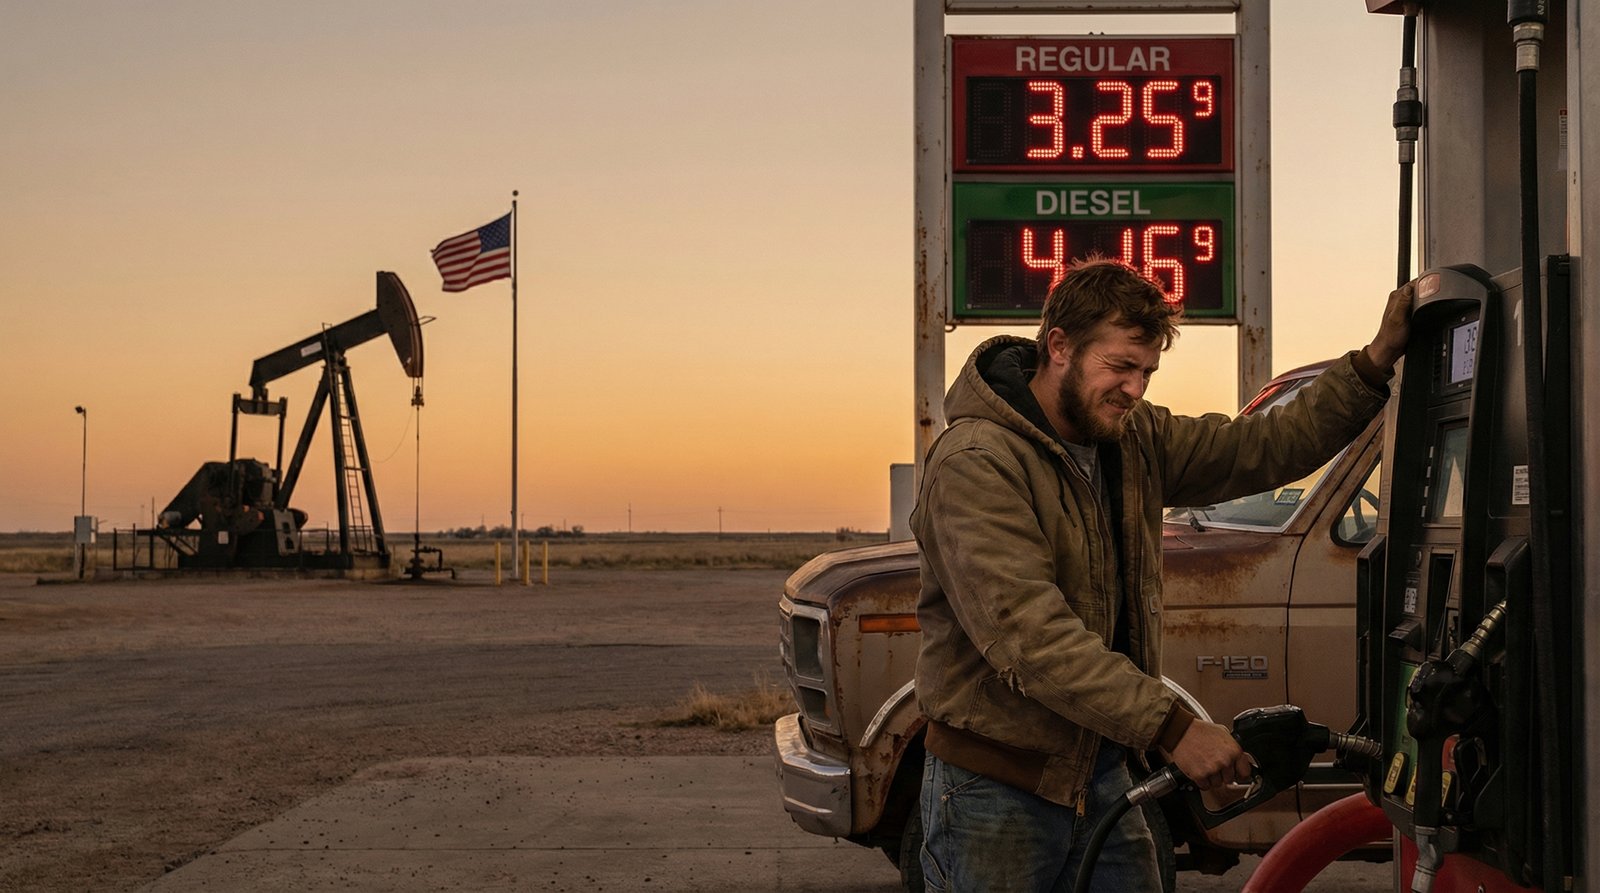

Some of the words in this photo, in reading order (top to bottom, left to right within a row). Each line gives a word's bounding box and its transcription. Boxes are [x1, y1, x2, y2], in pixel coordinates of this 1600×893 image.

[1015, 46, 1170, 71] REGULAR
[1027, 80, 1184, 158] 3.25
[1036, 190, 1151, 215] DIESEL
[1197, 655, 1269, 672] F-150
